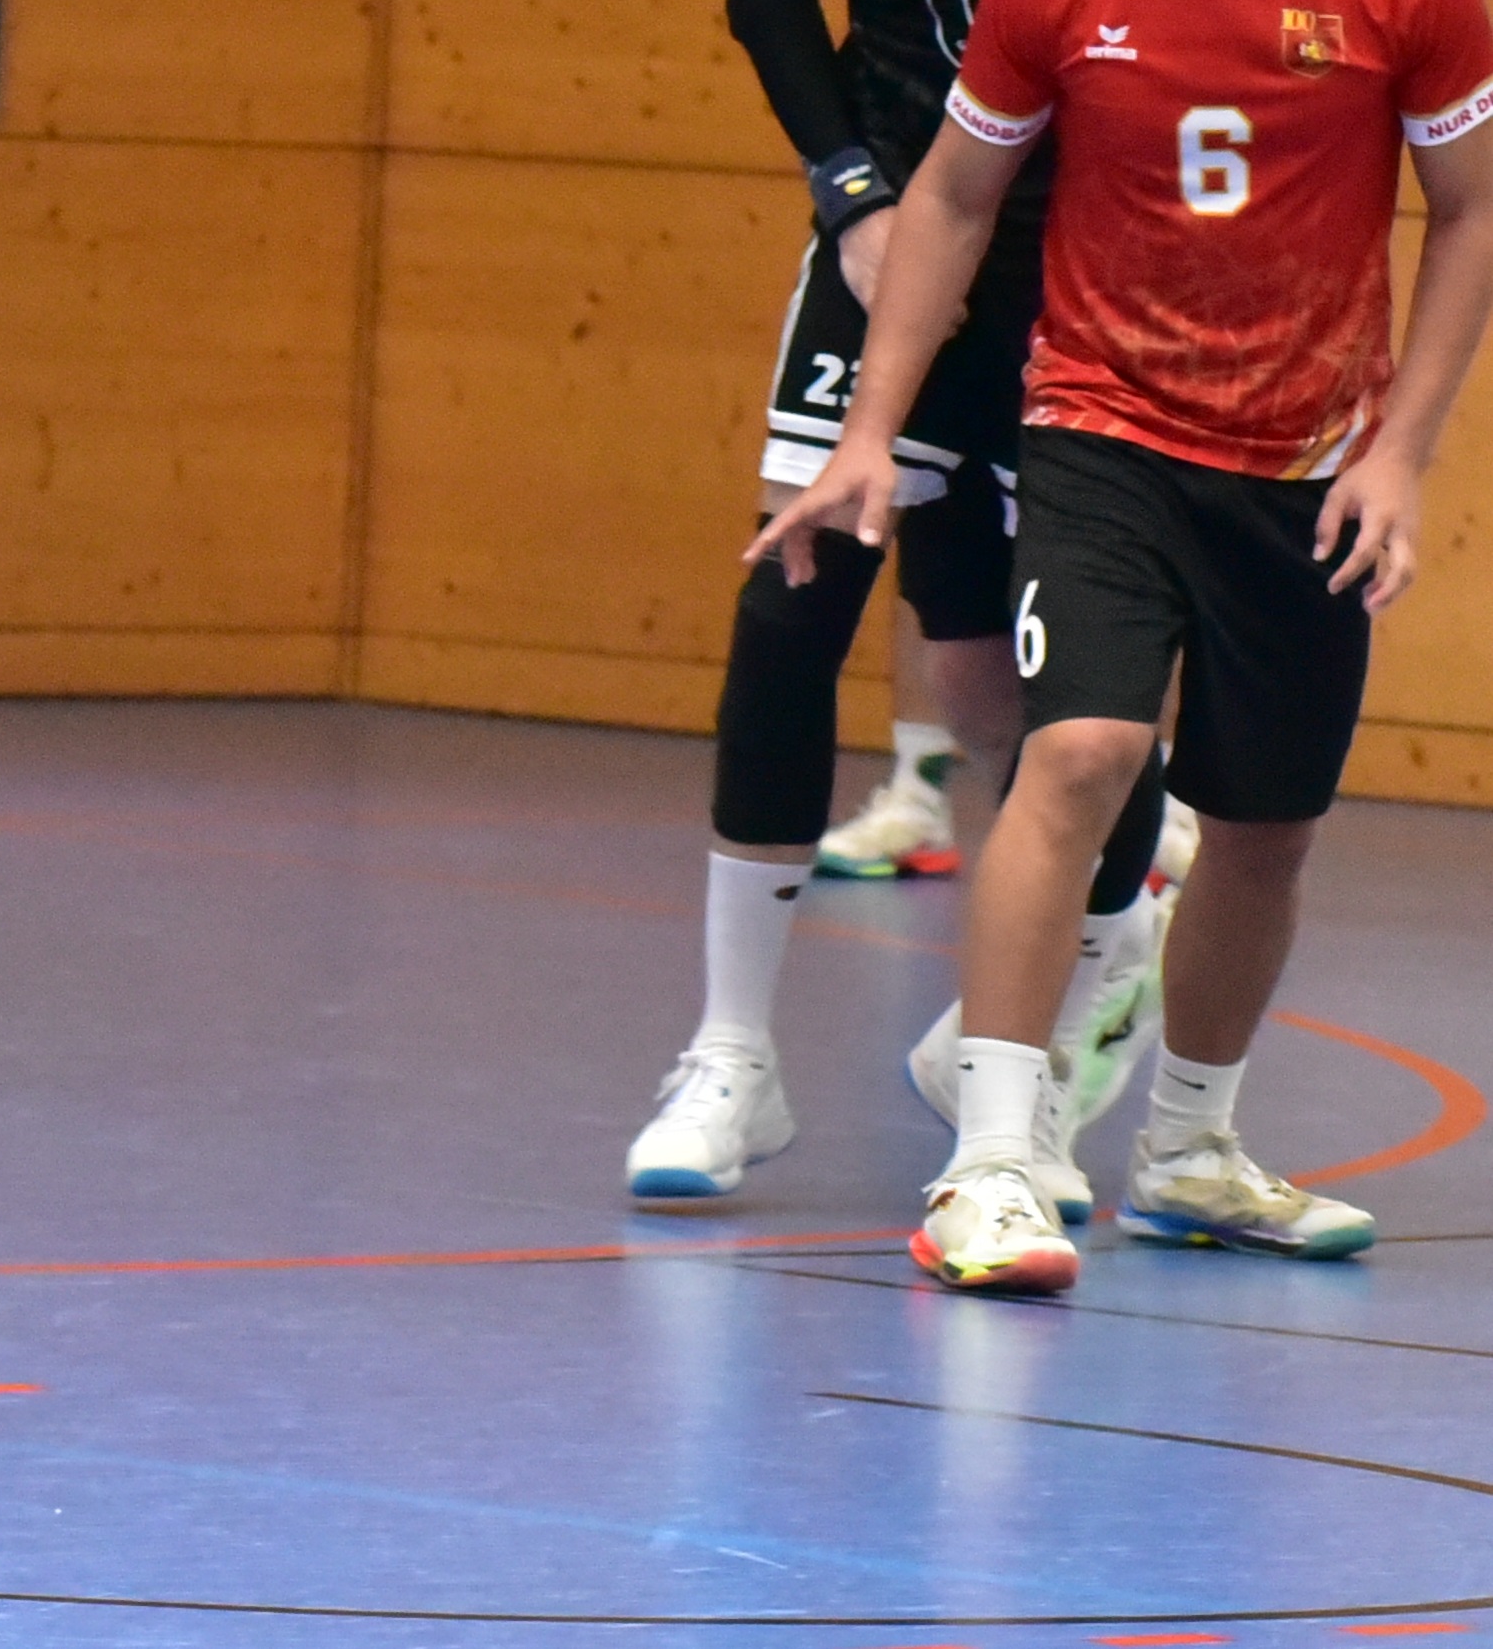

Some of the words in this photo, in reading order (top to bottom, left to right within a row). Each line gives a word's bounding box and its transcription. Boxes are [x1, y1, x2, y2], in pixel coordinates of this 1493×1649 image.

[1177, 103, 1254, 218] 6
[1426, 107, 1474, 139] NUR
[1014, 578, 1047, 679] 6
